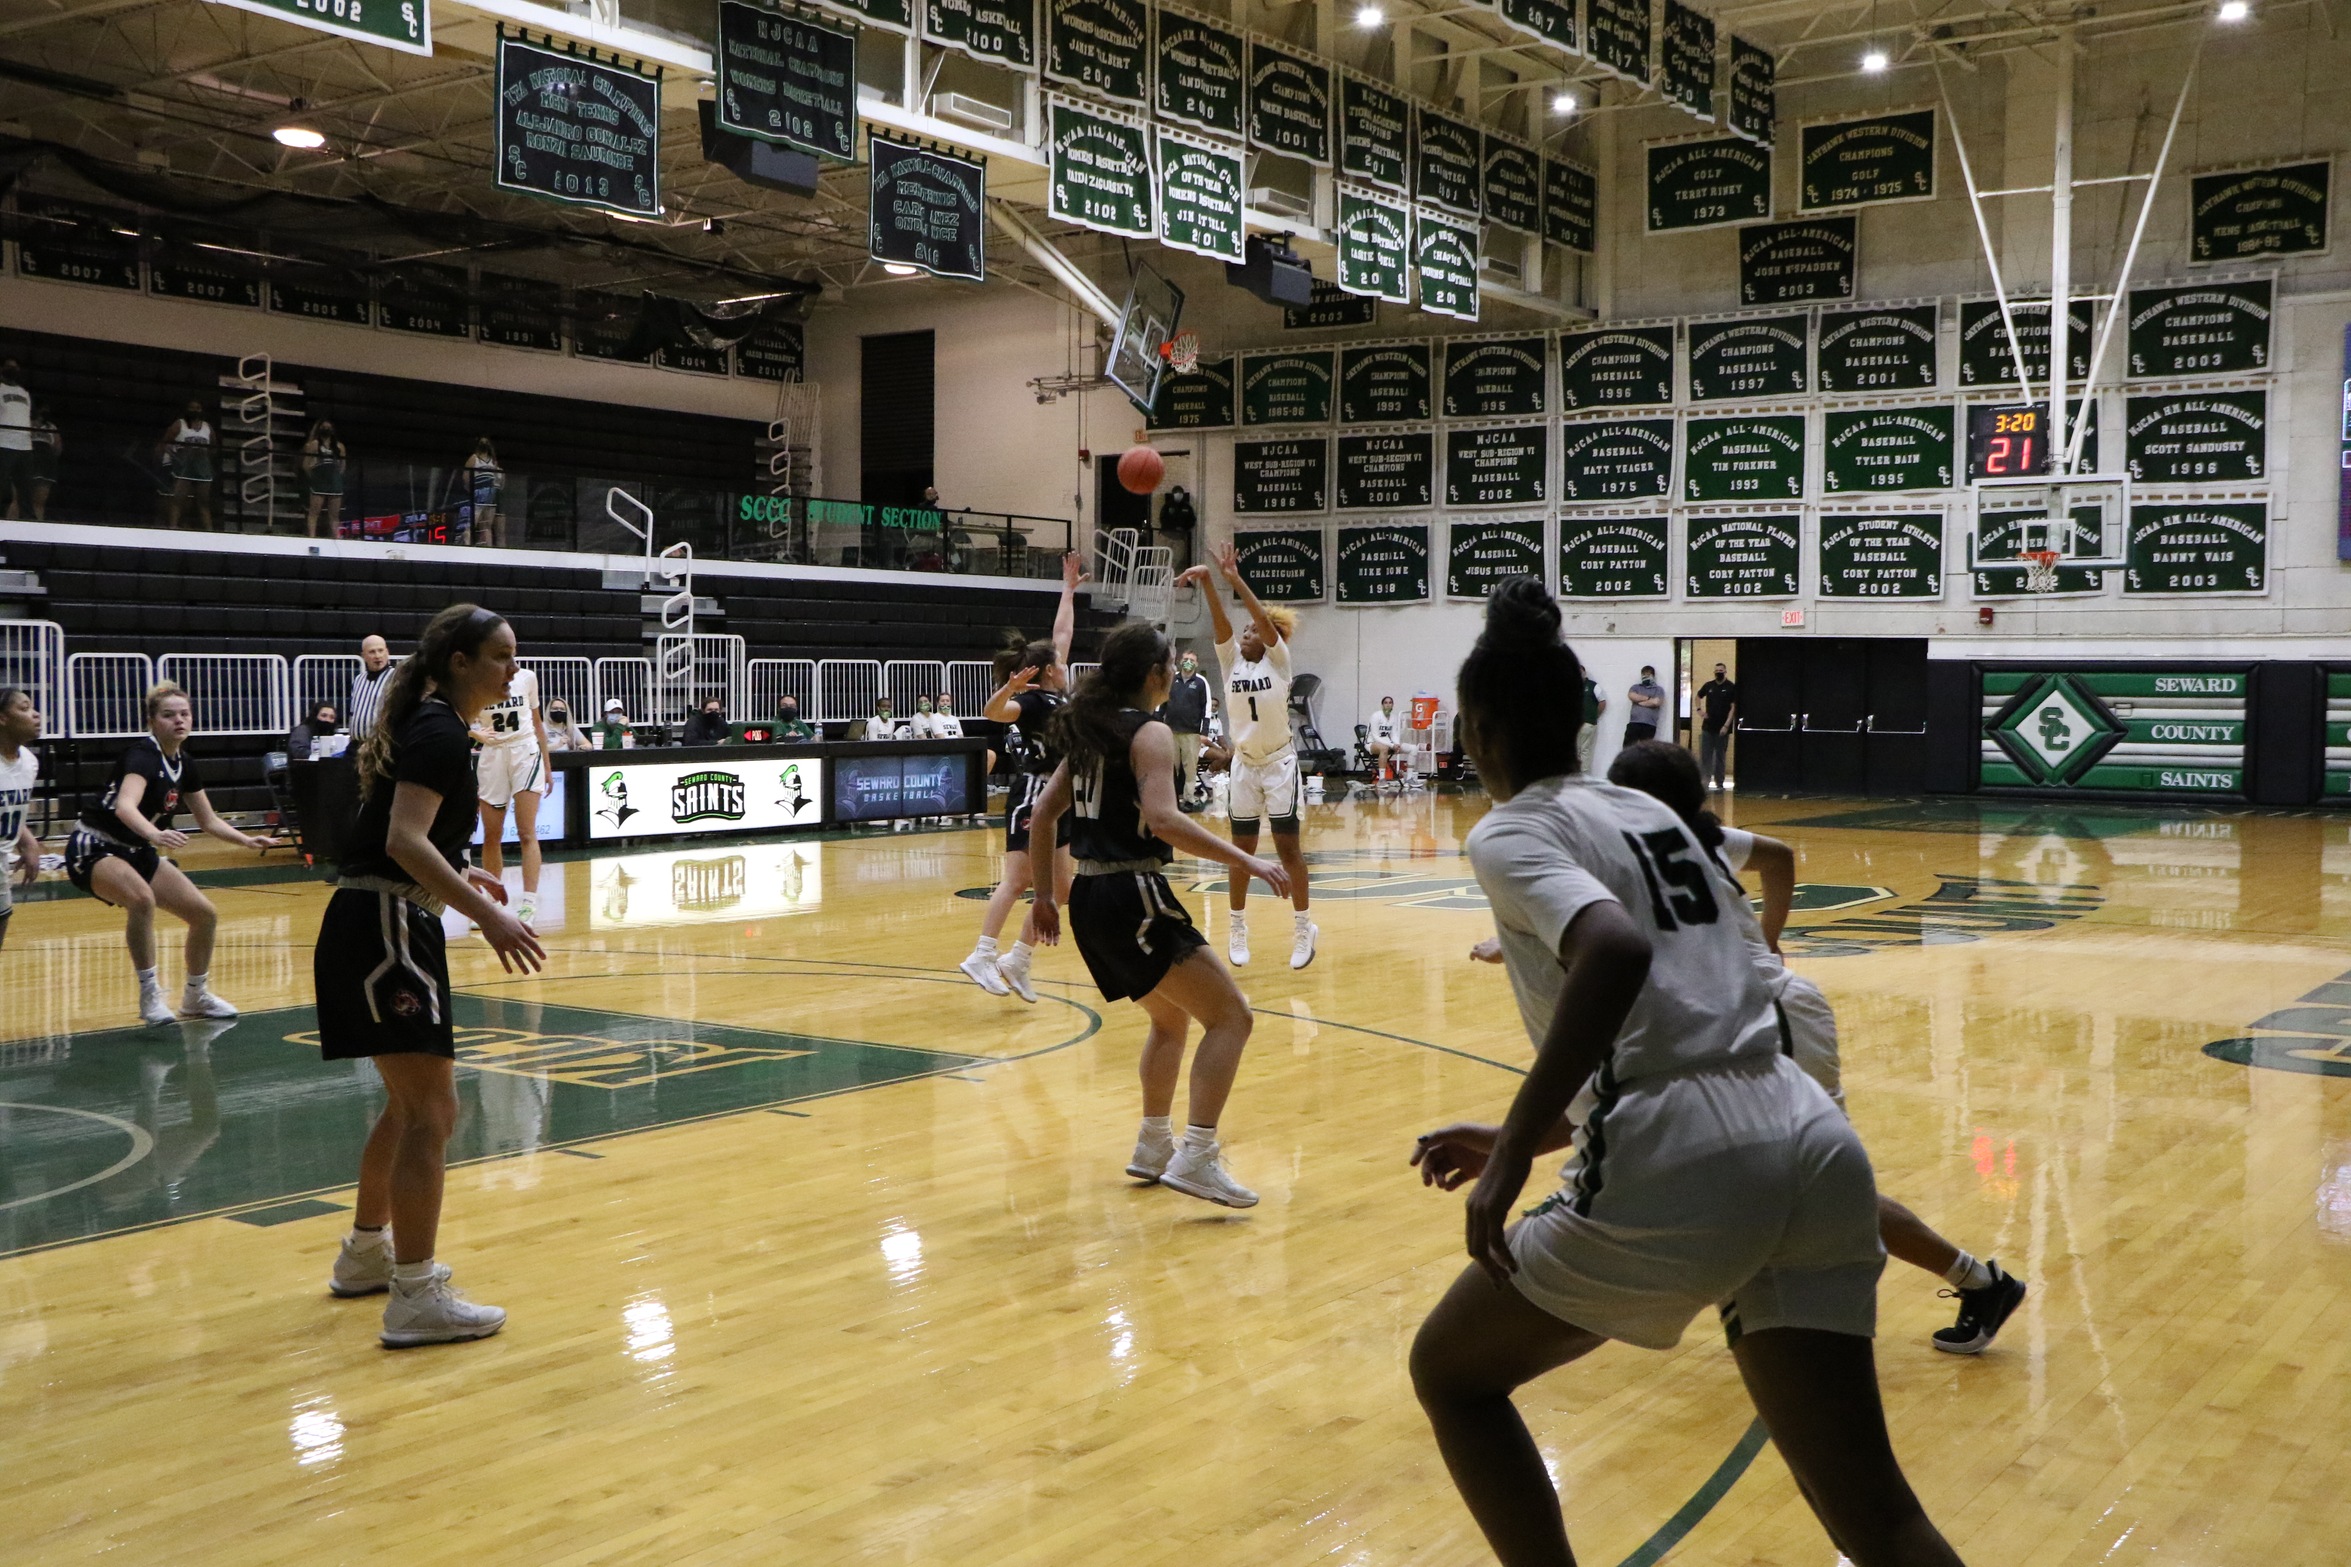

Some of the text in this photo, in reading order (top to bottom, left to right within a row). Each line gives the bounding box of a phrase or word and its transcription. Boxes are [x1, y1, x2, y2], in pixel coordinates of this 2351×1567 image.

[758, 20, 818, 52] NJCAA
[2131, 292, 2270, 331] JAYHAWK WESTERN DIVISION
[1964, 310, 2001, 341] JAYHAWK
[2165, 312, 2233, 327] CHAMPIONS
[1850, 336, 1905, 347] CHAMPIONS
[2163, 331, 2236, 346] BASEBALL
[1721, 344, 1774, 357] CHAMPIONS
[1845, 356, 1909, 367] BASEBALL
[2174, 354, 2223, 369] 2003
[1719, 362, 1776, 375] BASEBALL
[1731, 379, 1765, 391] 1997
[1857, 373, 1897, 385] 2001
[1995, 412, 2036, 432] 3:20
[2128, 410, 2161, 437] NJCAA
[2184, 401, 2263, 429] ALL-AMERICAN
[1832, 416, 1946, 448] NJCAA ALL-AMERICAN
[2161, 422, 2229, 435] BASEBALL
[1366, 440, 1404, 450] NJCAA
[1477, 433, 1516, 445] NJCAA
[1567, 426, 1671, 458] NJCAA ALL-AMERICAN
[1691, 425, 1800, 455] NJCAA ALL-AMERICAN
[1861, 435, 1916, 447] BASEBALL
[1262, 445, 1298, 455] NJCAA
[1593, 446, 1644, 457] BASEBALL
[1722, 445, 1771, 455] BASEBALL
[2145, 441, 2245, 455] SCOTT SANDUSKY
[1856, 454, 1920, 466] TYLER BAIN
[1986, 437, 2032, 473] 21
[1584, 462, 1654, 475] MATT YEAGER
[1712, 461, 1777, 472] TIM FORKNER
[2170, 463, 2218, 474] 1996
[1471, 472, 1520, 483] BASEBALL
[1871, 474, 1904, 485] 1995
[1257, 483, 1302, 492] BASEBALL
[1602, 481, 1637, 493] 1975
[1730, 480, 1759, 490] 1993
[1479, 489, 1512, 499] 2002
[1264, 498, 1296, 507] 1986
[807, 499, 875, 526] STUDENT
[881, 507, 942, 530] SECTION
[2185, 512, 2265, 544] ALL-AMERICAN
[1563, 530, 1593, 554] NJCAA
[1597, 525, 1665, 551] ALL-AMERICAN
[1689, 522, 1797, 551] NJCAA NATIONAL PLAYER
[1822, 520, 1940, 550] NJCAA STUDENT ATHLETE
[2160, 533, 2229, 545] BASEBALL
[1715, 537, 1771, 548] OF THE YEAR
[1850, 537, 1910, 547] OF THE YEAR
[1590, 544, 1638, 553] BASEBALL
[1719, 553, 1767, 562] BASEBALL
[1854, 552, 1907, 562] BASEBALL
[2153, 552, 2233, 563] DANNY VAIS
[1581, 560, 1646, 569] CORY PATTON
[1709, 568, 1775, 579] CORY PATTON
[1843, 568, 1916, 578] CORY PATTON
[1596, 581, 1631, 591] 2002
[2169, 575, 2218, 586] 2003
[1724, 583, 1762, 595] 2002
[1859, 583, 1901, 594] 2002
[1785, 611, 1800, 624] EXIT
[2155, 678, 2237, 693] SEWARD
[1248, 696, 1258, 722] 1
[1416, 703, 1423, 713] G
[492, 710, 519, 732] 24
[2151, 725, 2234, 742] COUNTY
[685, 774, 732, 786] SEWARD COUNTY
[857, 774, 942, 790] SEWARD COUNTY
[2160, 772, 2233, 788] SAINTS
[674, 783, 743, 816] SAINTS
[864, 790, 935, 802] BASKETBALL
[1620, 826, 1719, 932] 15
